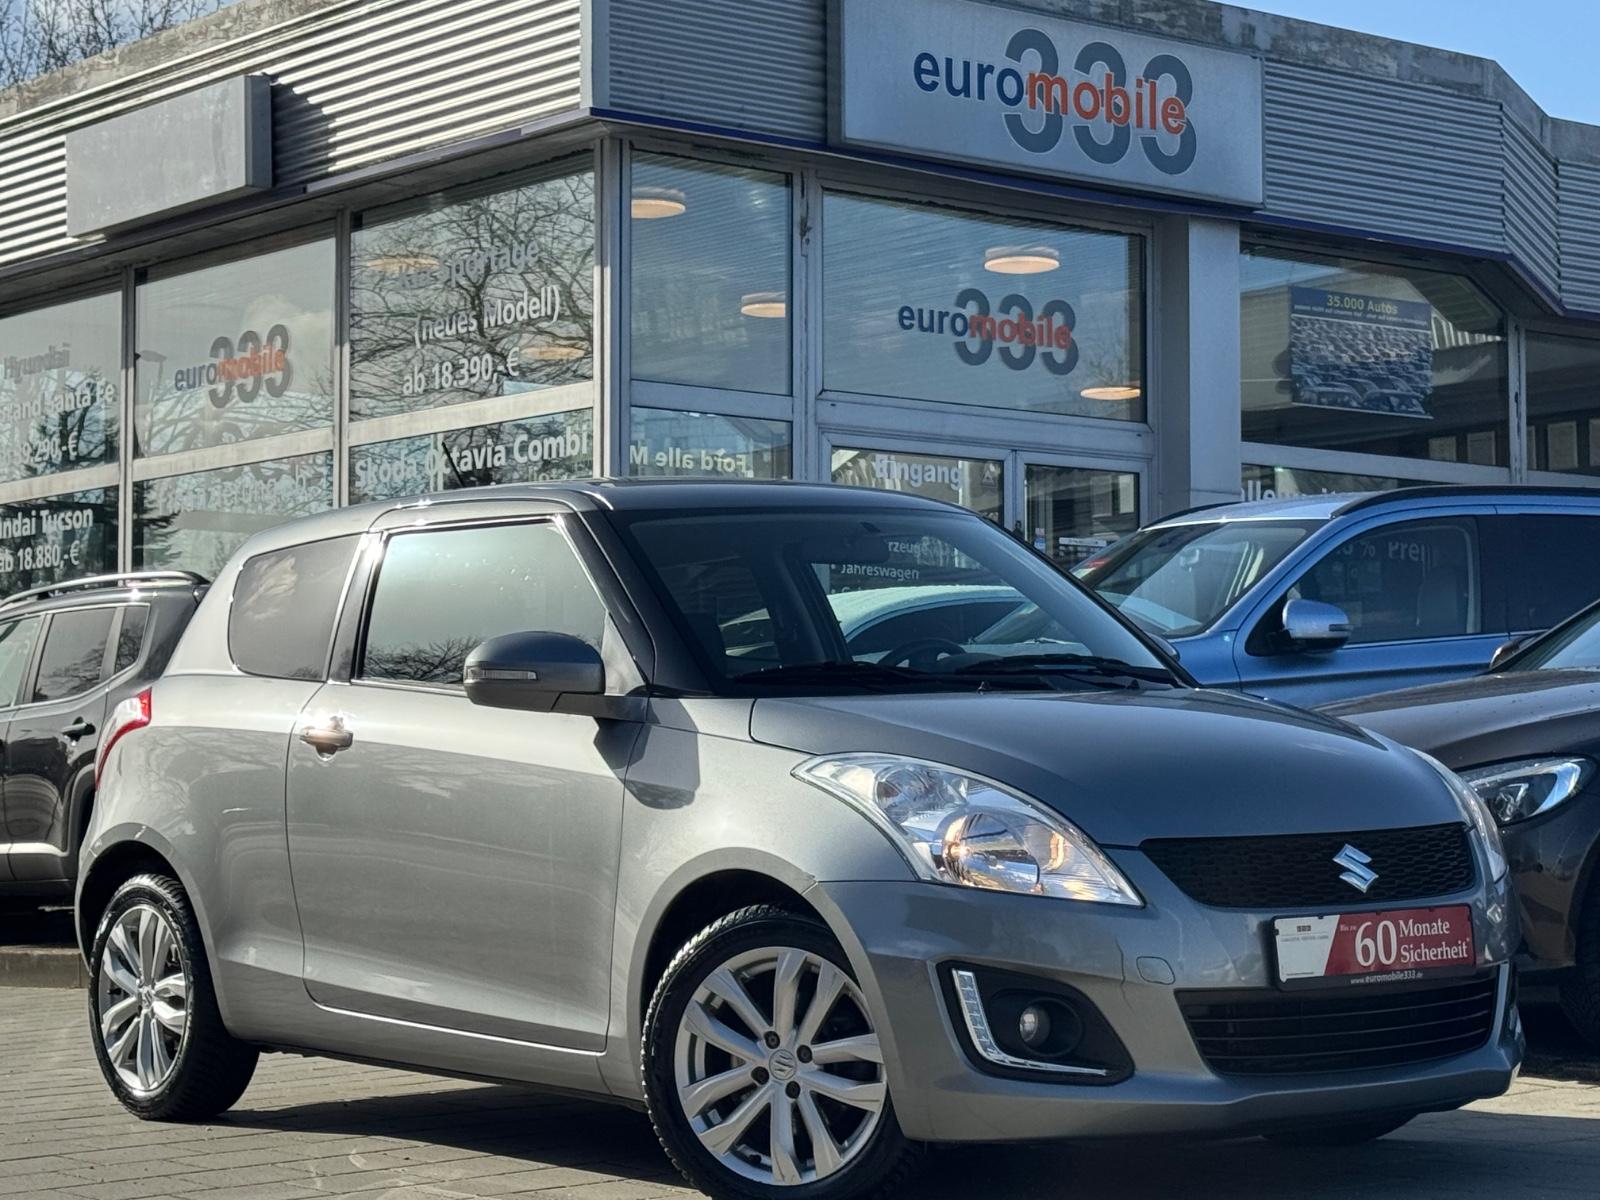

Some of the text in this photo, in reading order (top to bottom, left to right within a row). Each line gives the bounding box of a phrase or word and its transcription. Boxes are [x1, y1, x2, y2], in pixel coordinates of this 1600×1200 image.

[913, 51, 1187, 135] euromobile
[1003, 28, 1197, 175] 333
[413, 285, 561, 349] (neues Modell)
[898, 304, 1072, 351] euromobile
[1326, 294, 1399, 315] 35.000 Autos
[953, 288, 1079, 376] 333
[174, 345, 286, 392] euromobile
[208, 323, 292, 408] 333
[402, 346, 520, 396] ab 18.390,-€
[425, 439, 506, 475] Octavia
[513, 424, 589, 464] Combi
[876, 453, 962, 491] Eingang
[40, 508, 94, 534] Tucson
[17, 540, 80, 570] 18.880,-€
[840, 564, 920, 581] Jahreswagen
[1355, 920, 1398, 967] 60
[1399, 917, 1450, 938] Monate
